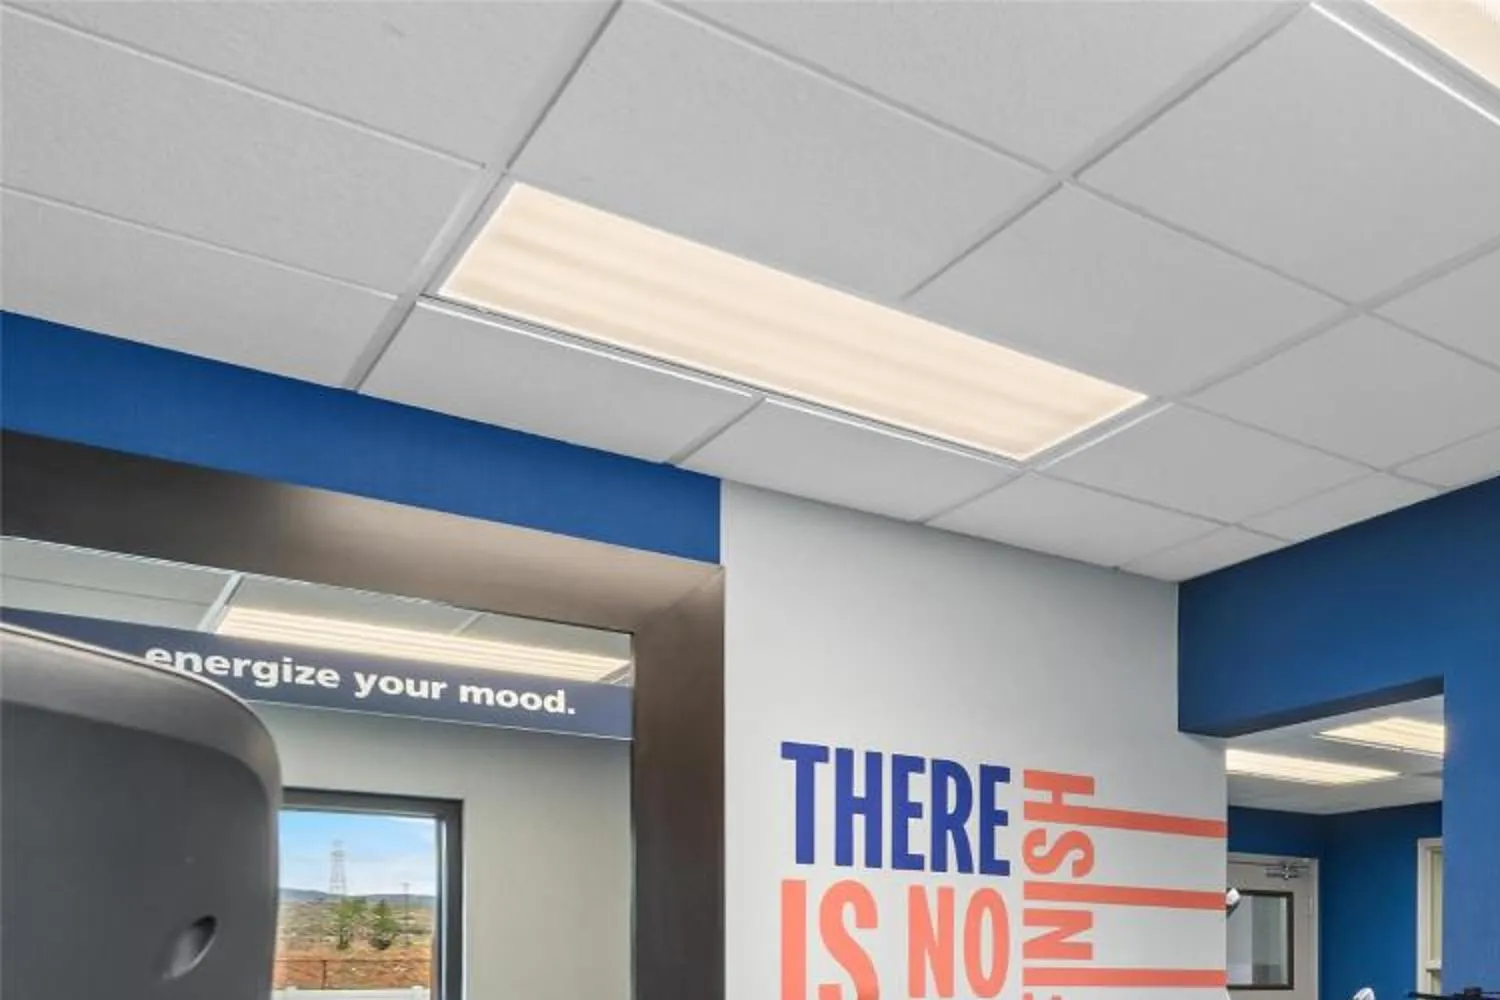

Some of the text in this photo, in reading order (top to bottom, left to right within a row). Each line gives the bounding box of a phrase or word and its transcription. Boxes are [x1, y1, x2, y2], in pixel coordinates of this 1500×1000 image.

[145, 647, 576, 715] energize your mood.
[780, 741, 1011, 876] THERE
[907, 884, 1010, 999] NO
